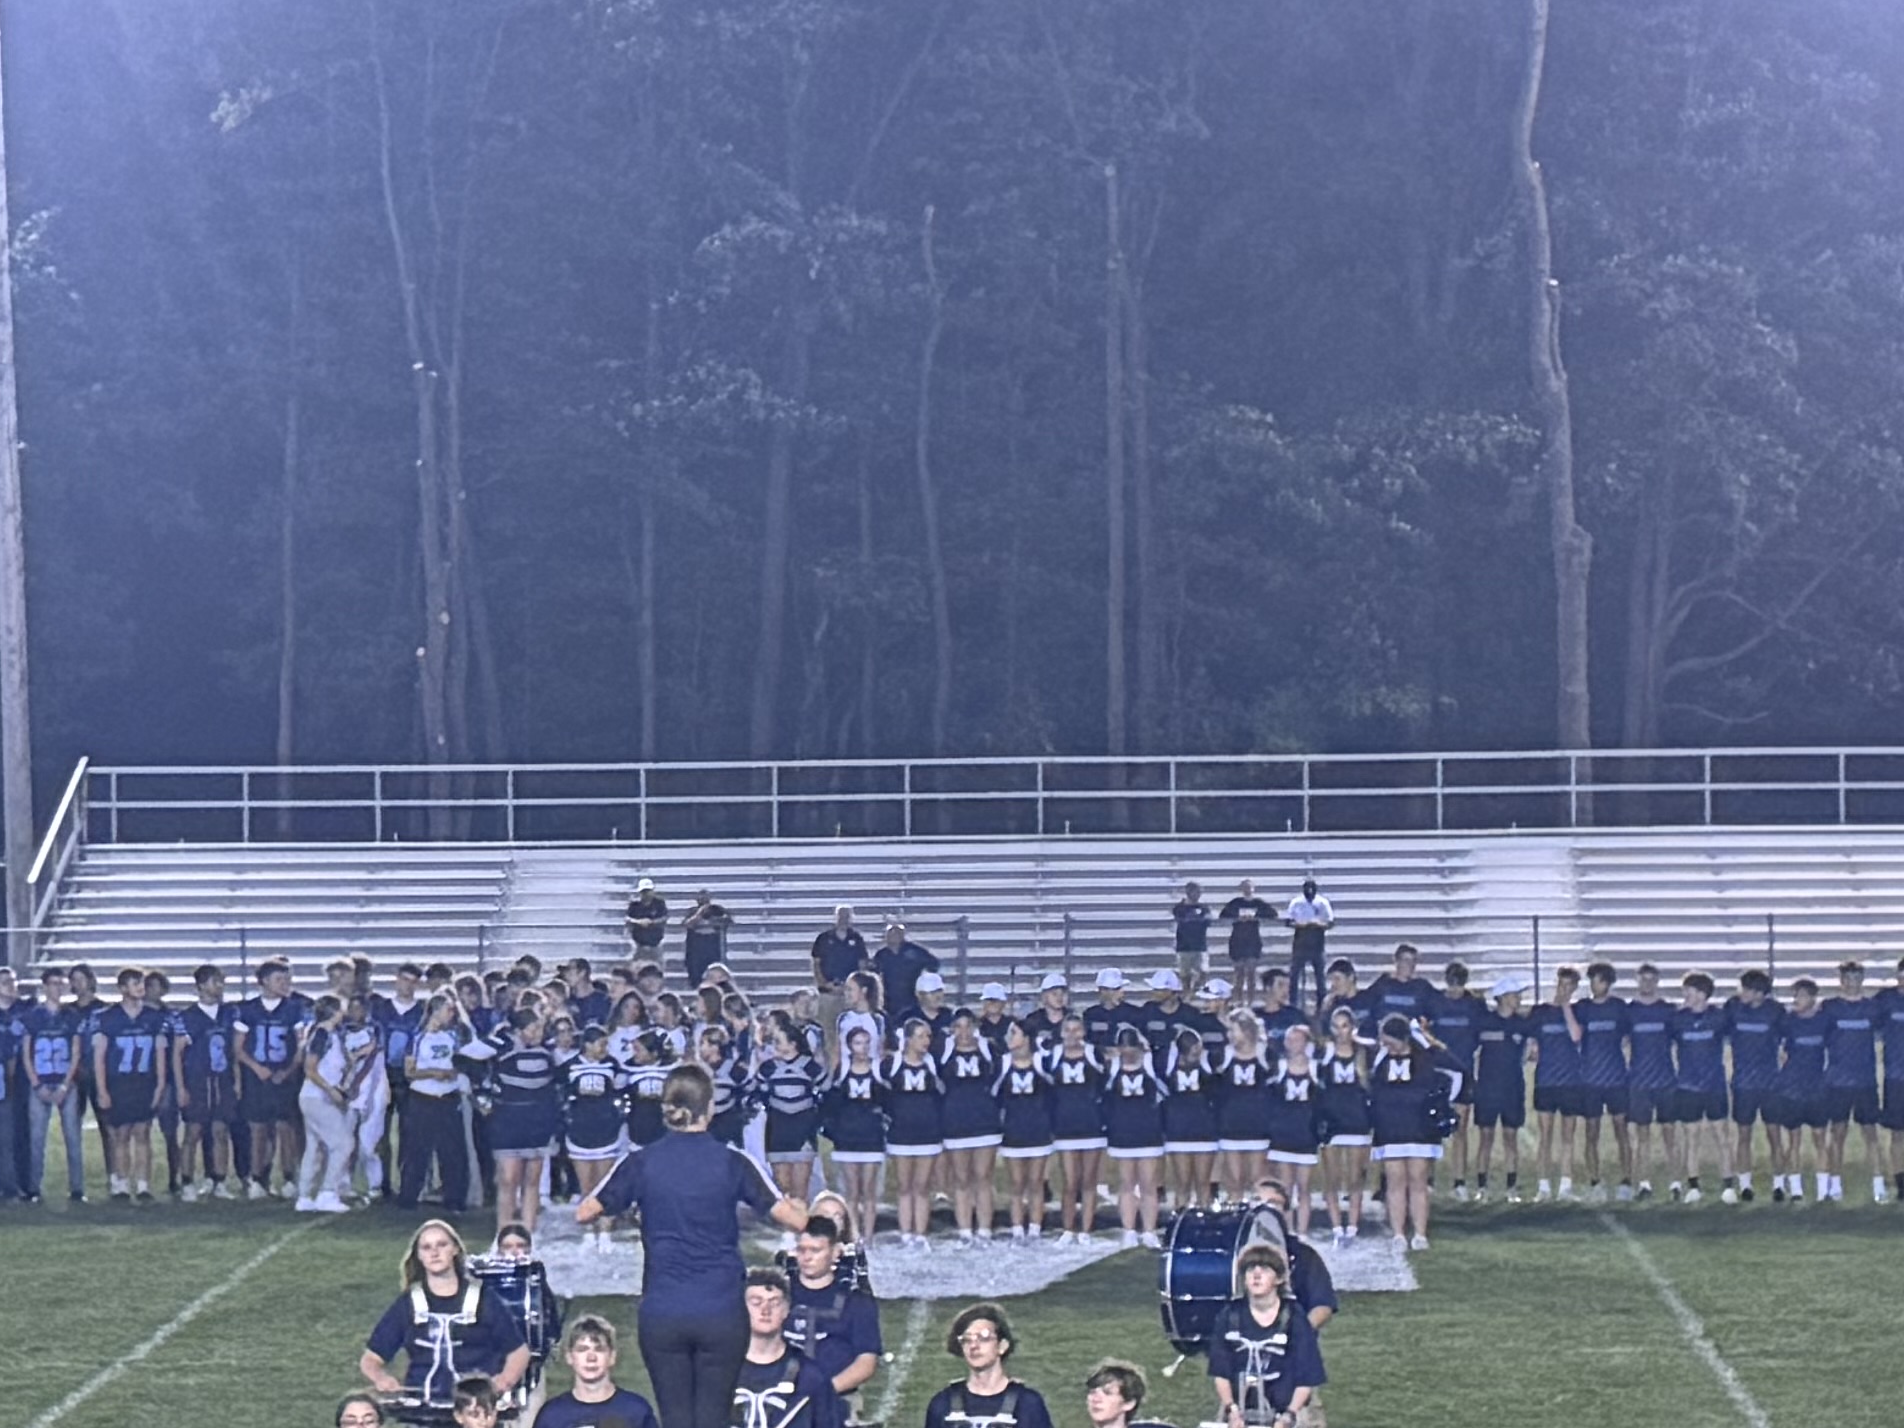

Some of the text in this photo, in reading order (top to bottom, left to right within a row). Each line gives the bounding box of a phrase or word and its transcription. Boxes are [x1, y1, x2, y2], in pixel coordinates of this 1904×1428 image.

[115, 1035, 153, 1073] 77
[253, 1025, 288, 1063] 15
[956, 1055, 980, 1077] M
[1062, 1062, 1085, 1084] M
[1233, 1064, 1256, 1086] M
[1333, 1062, 1355, 1084] M
[1387, 1059, 1411, 1081] M
[849, 1077, 872, 1099] M
[904, 1069, 926, 1091] M
[1011, 1072, 1034, 1094] M
[1121, 1073, 1145, 1096] M
[1177, 1069, 1200, 1091] M
[1285, 1079, 1308, 1101] M
